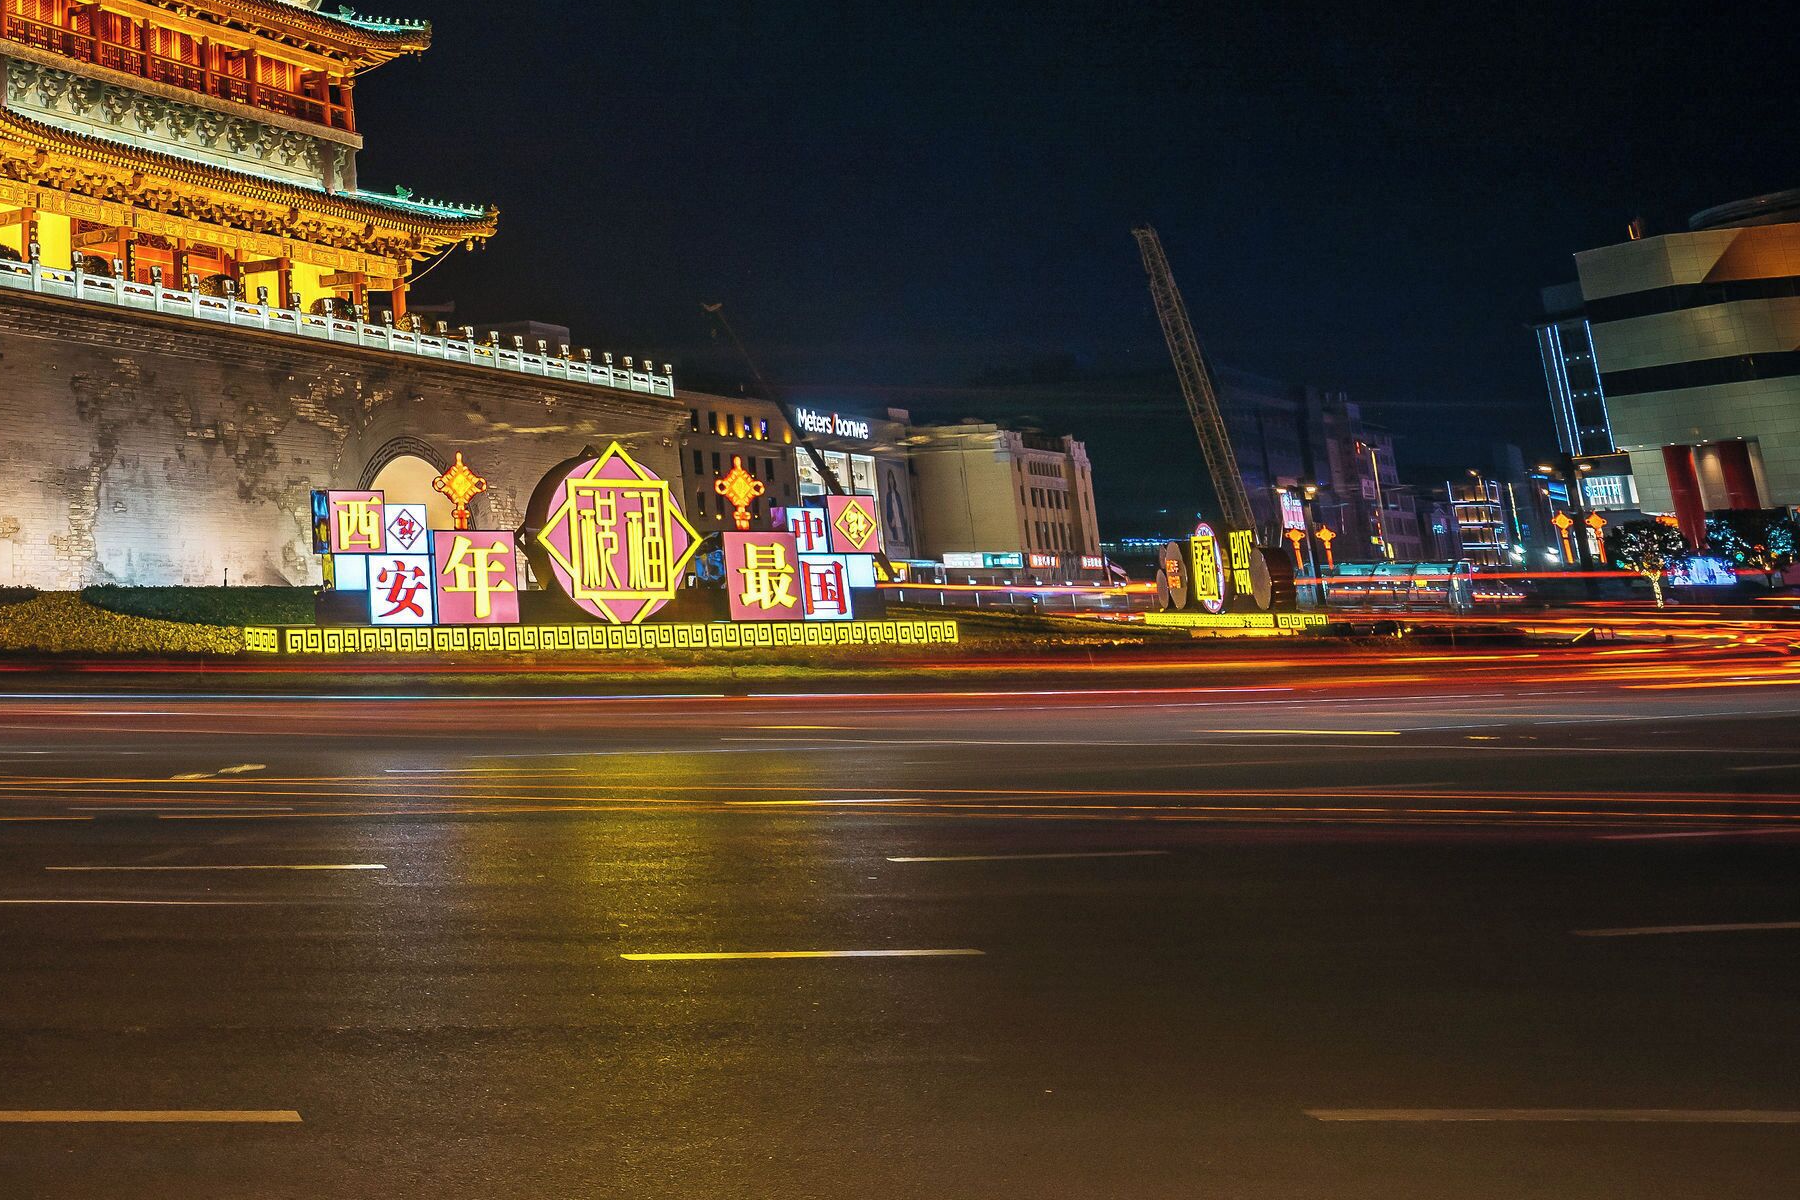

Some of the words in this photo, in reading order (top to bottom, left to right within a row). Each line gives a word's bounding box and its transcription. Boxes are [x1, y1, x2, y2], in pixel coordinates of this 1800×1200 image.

[796, 408, 869, 440] Meters/bonwe
[578, 489, 665, 590] 祝福
[377, 560, 428, 618] 安
[441, 535, 515, 618] 年
[739, 542, 798, 610] 最
[801, 560, 847, 616] 国
